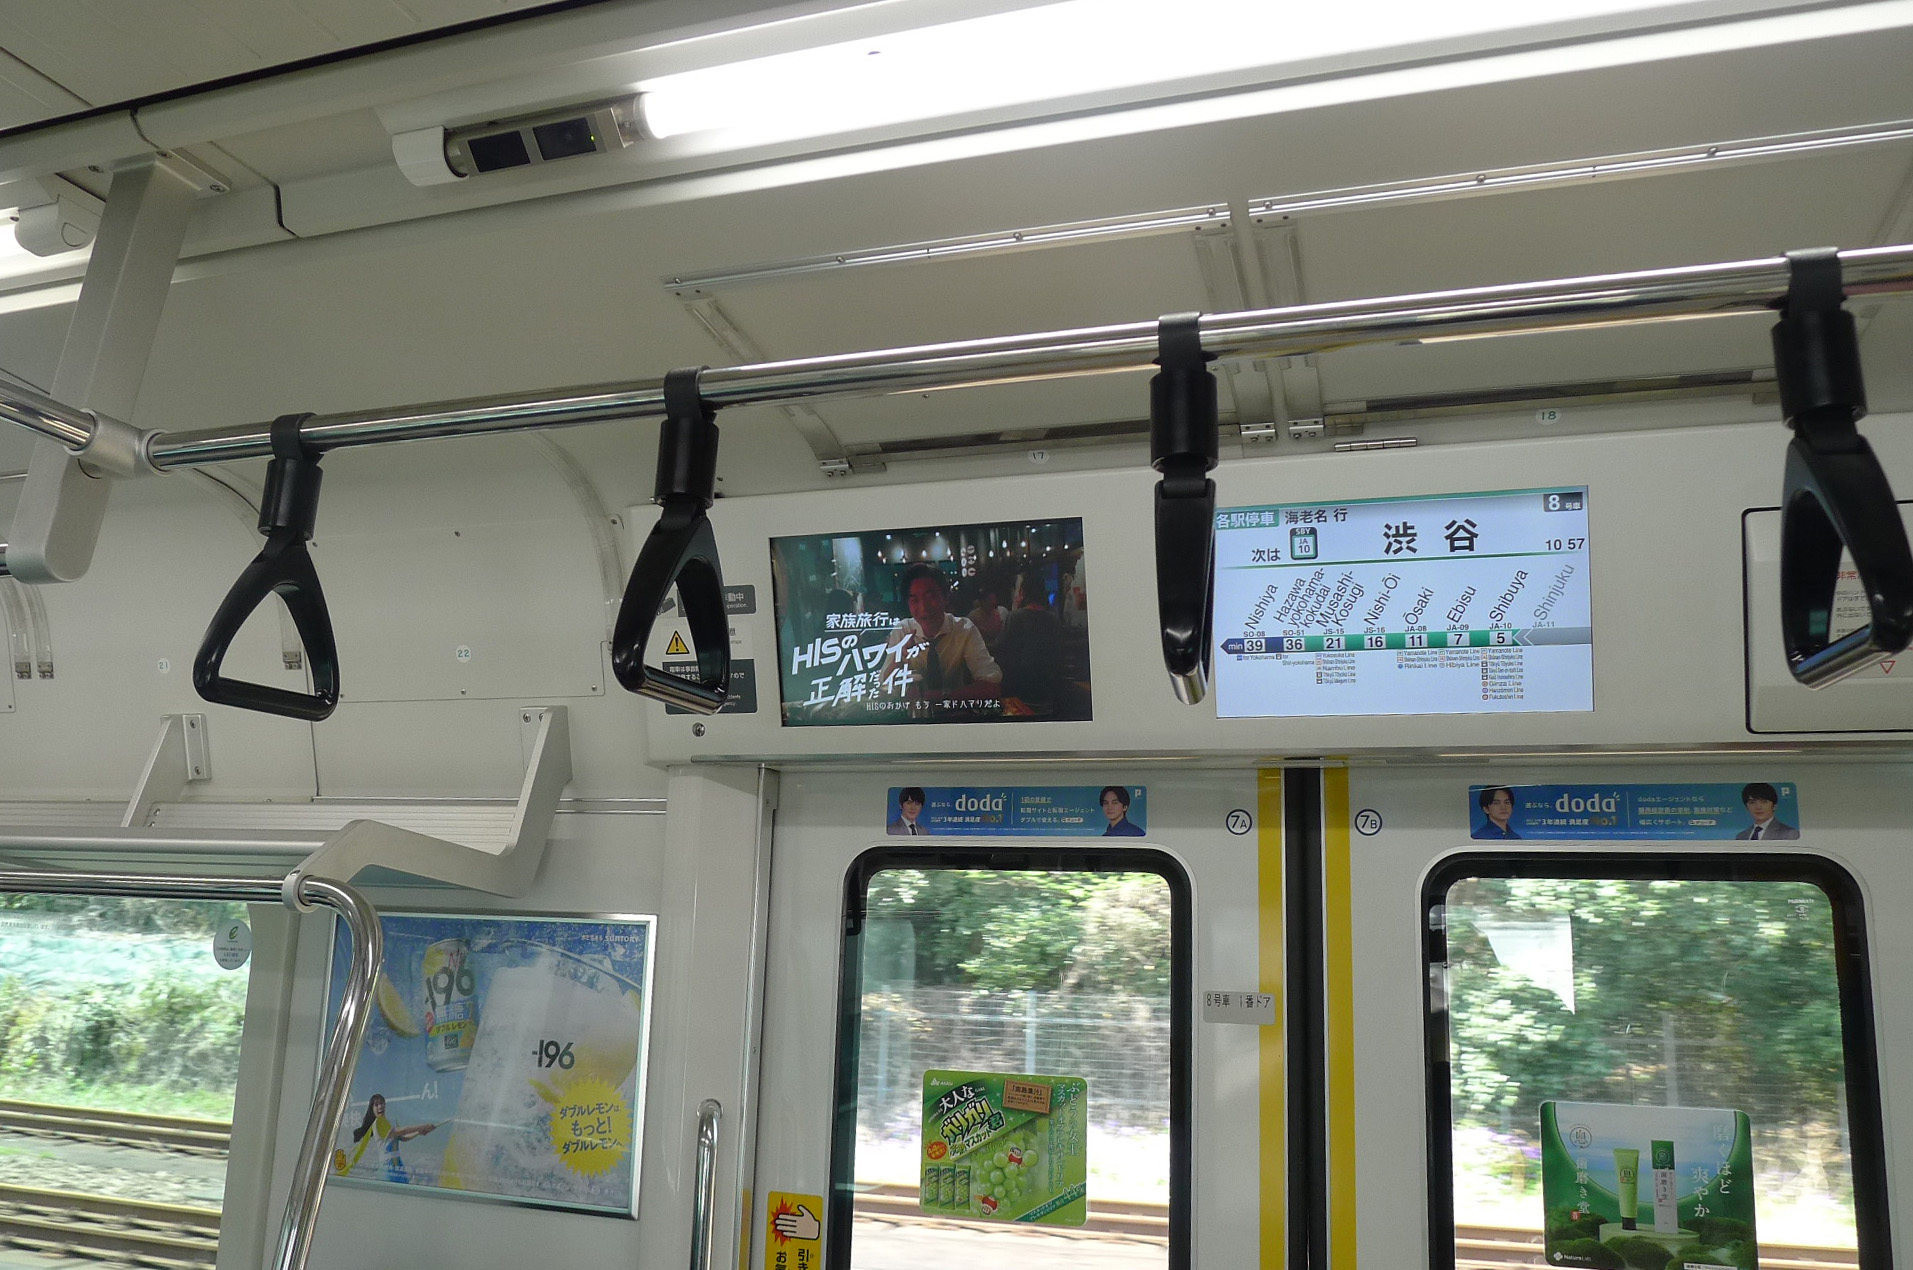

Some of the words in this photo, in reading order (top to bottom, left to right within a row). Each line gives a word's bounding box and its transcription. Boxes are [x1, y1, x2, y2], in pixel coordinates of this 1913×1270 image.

[1541, 410, 1556, 421] 18
[1032, 451, 1044, 460] 17
[1548, 494, 1560, 511] 8
[1216, 510, 1275, 529] 各駅停車
[1284, 509, 1328, 525] 海老名
[1333, 508, 1348, 522] 行
[1295, 527, 1311, 535] SBY
[1251, 548, 1281, 563] 次は
[1298, 545, 1311, 554] 10
[1273, 577, 1306, 623] Hazawa
[1288, 568, 1325, 629] yokohama-
[1315, 571, 1353, 628] Musashi-
[1363, 573, 1401, 626] Nishi-Ōi
[1489, 569, 1529, 622] Shibuya
[1533, 564, 1575, 621] Shinjuku
[1245, 583, 1279, 630] Nishiya
[1300, 584, 1332, 629] kokudai
[1331, 582, 1365, 627] Kosugi
[1402, 586, 1435, 625] Ōsaki
[1447, 585, 1477, 624] Ebisu
[825, 612, 901, 629] 家族旅行は
[1405, 625, 1427, 633] JA-08
[1447, 623, 1469, 631] JA-09
[1489, 622, 1512, 630] JA-10
[1282, 629, 1305, 637] SO-51
[1323, 628, 1345, 636] JS-15
[1228, 642, 1243, 651] min
[1246, 640, 1263, 652] 39
[1285, 639, 1303, 650] 36
[1326, 637, 1342, 649] 21
[1367, 636, 1384, 648] 16
[1409, 635, 1423, 647] 11
[1454, 633, 1463, 645] 7
[1496, 632, 1506, 644] 5
[457, 649, 470, 658] 22
[915, 700, 930, 710] もう
[954, 793, 1003, 812] doda
[1555, 793, 1616, 813] doda
[1231, 815, 1247, 829] 7A
[1361, 815, 1377, 829] 7B
[1206, 993, 1230, 1008] 8号車
[532, 1039, 575, 1070] -196
[939, 1085, 975, 1114] 大人な
[560, 1102, 621, 1120] ダブルレモンは
[1691, 1166, 1710, 1217] 爽やか
